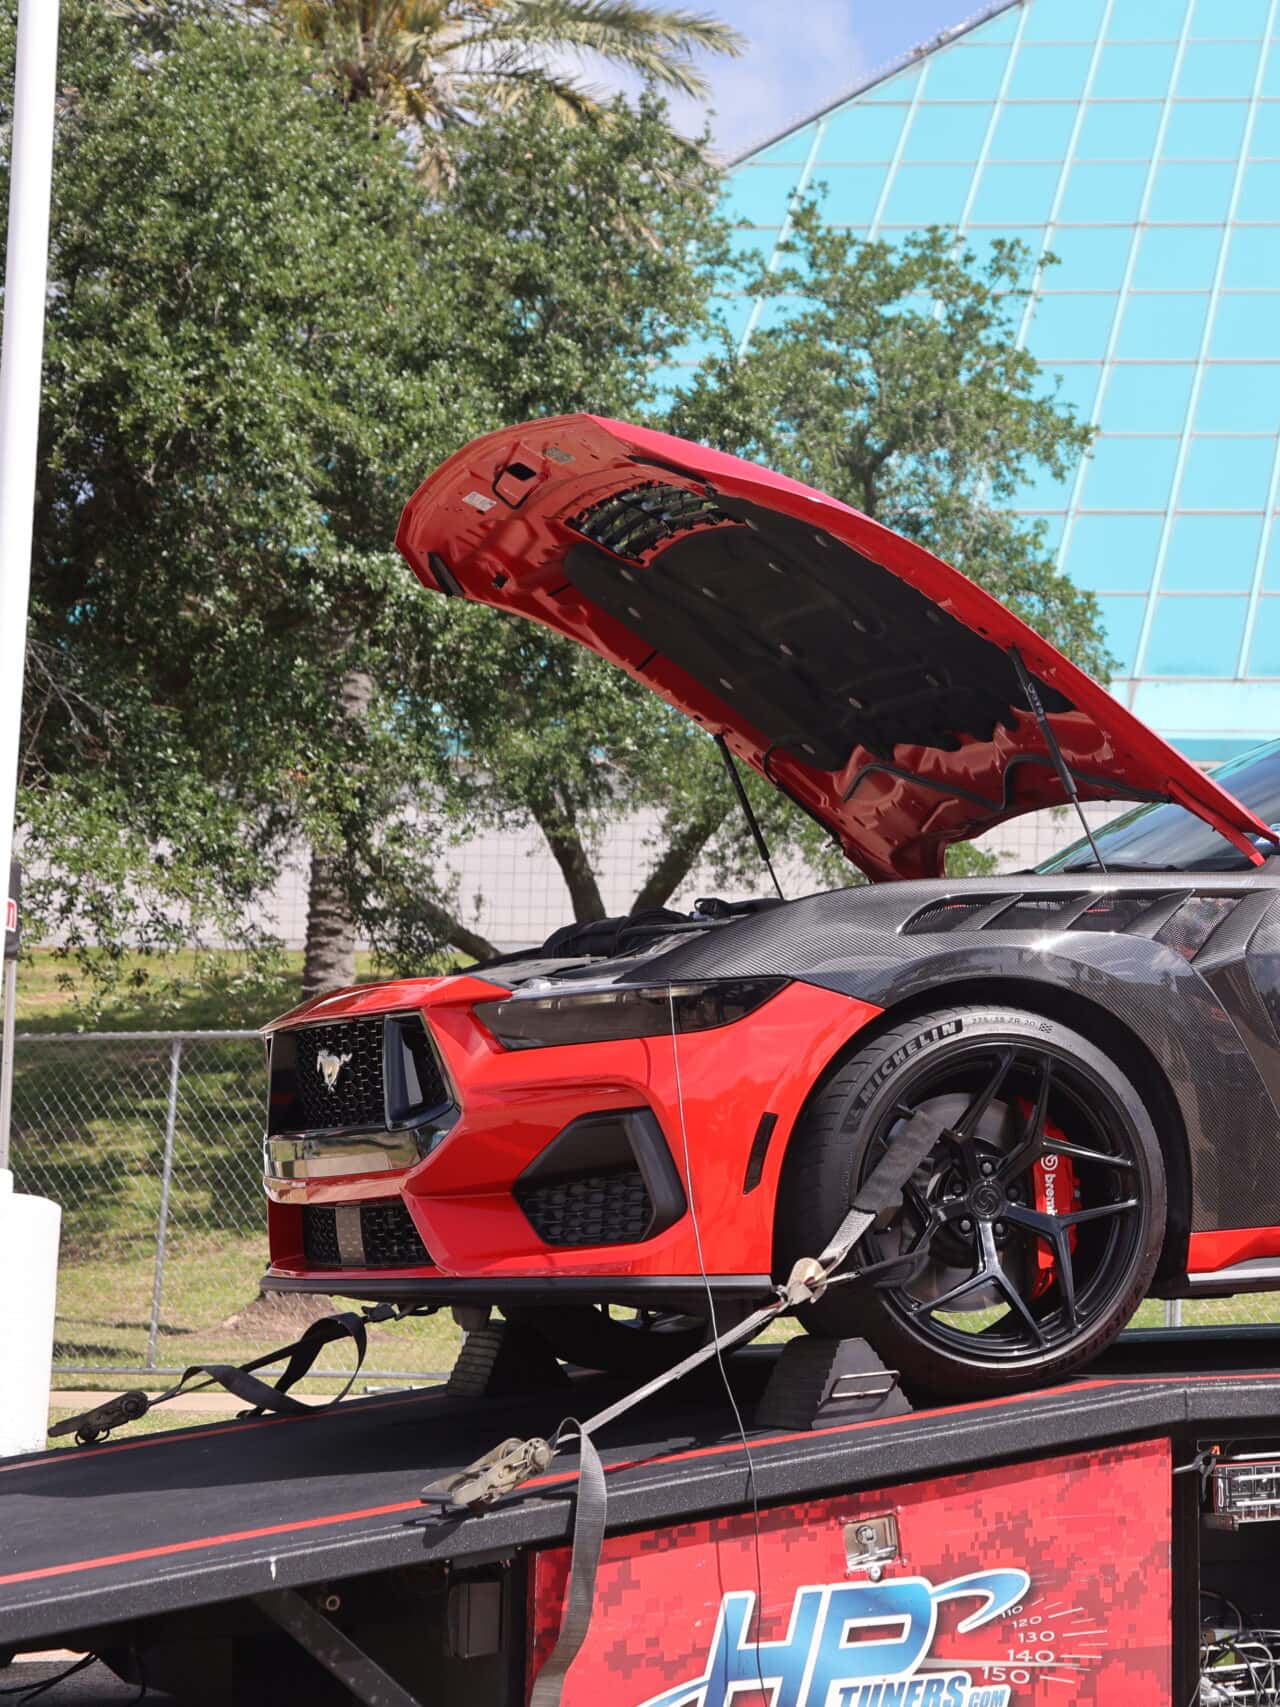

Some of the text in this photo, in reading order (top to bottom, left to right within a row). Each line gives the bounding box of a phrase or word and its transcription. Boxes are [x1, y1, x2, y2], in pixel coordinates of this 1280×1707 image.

[858, 1021, 957, 1103] MICHELIN
[1001, 1604, 1024, 1619] 110
[1012, 1615, 1042, 1629] 120
[701, 1580, 937, 1707] HP
[1018, 1630, 1055, 1644] 130
[1007, 1649, 1055, 1664] 140
[981, 1665, 1031, 1685] 150
